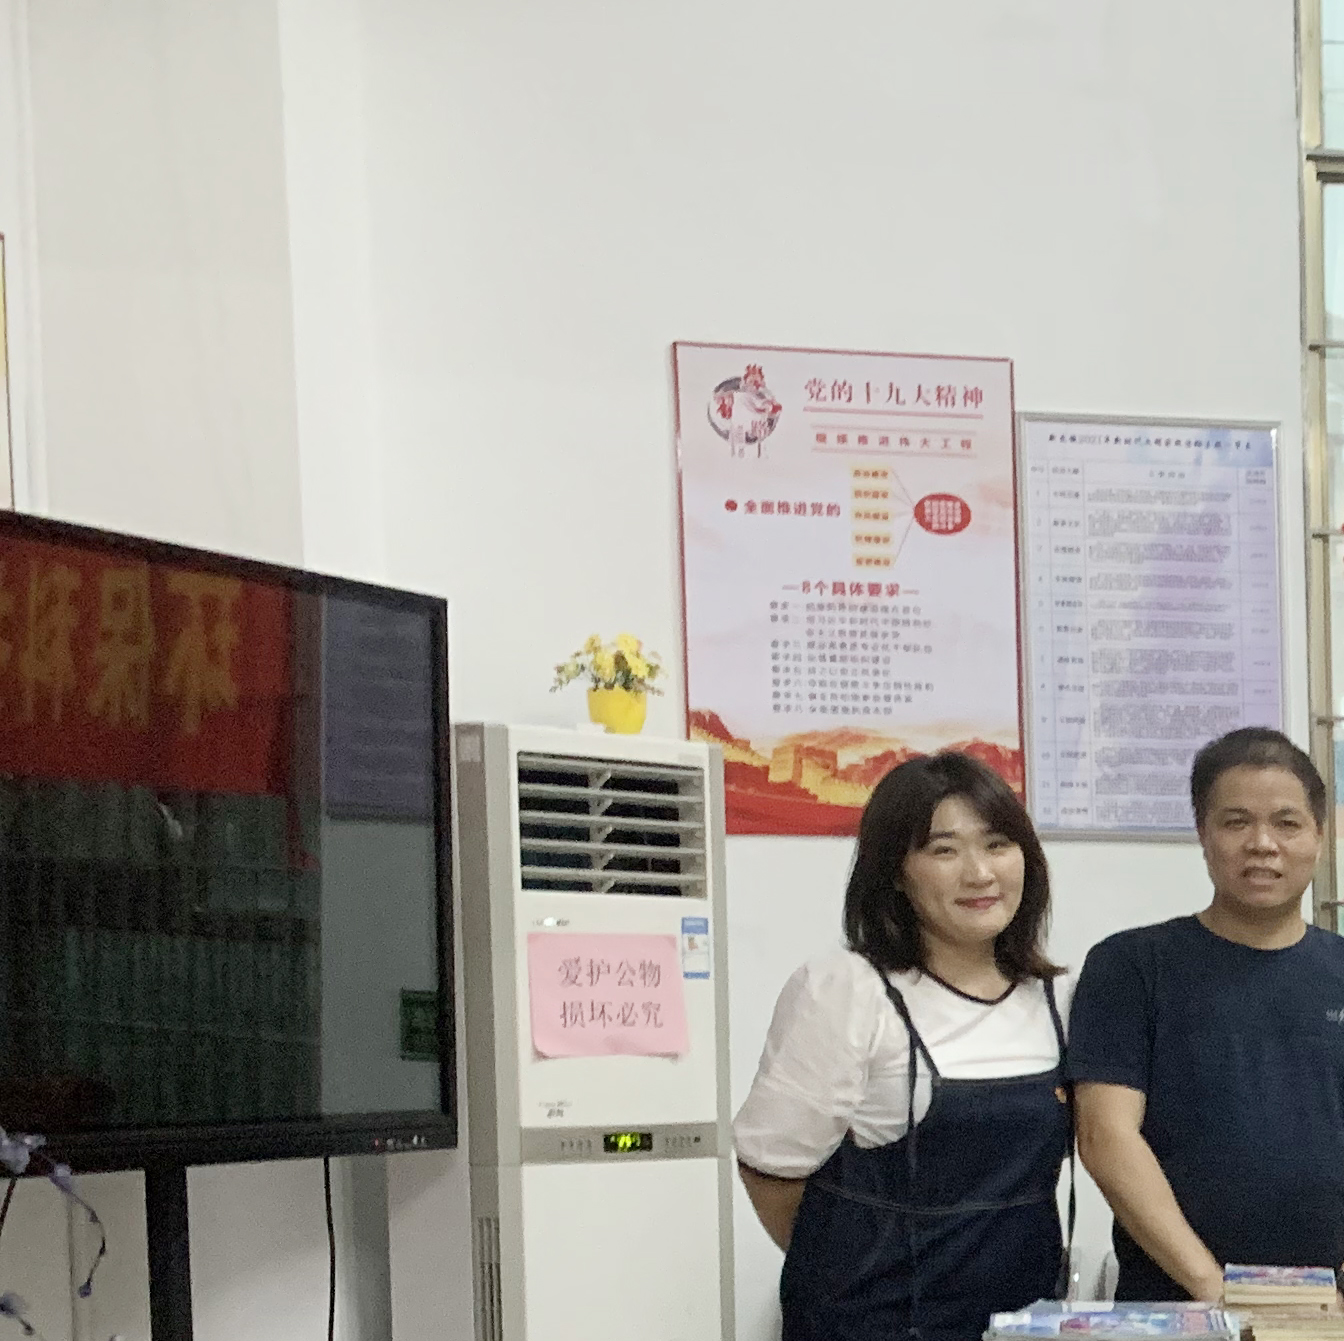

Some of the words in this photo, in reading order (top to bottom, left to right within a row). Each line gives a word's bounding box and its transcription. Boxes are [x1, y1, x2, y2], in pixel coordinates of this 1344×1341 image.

[804, 377, 984, 409] 党的十九大精神
[558, 956, 661, 988] 爱护公物
[560, 999, 664, 1028] 损坏必究
